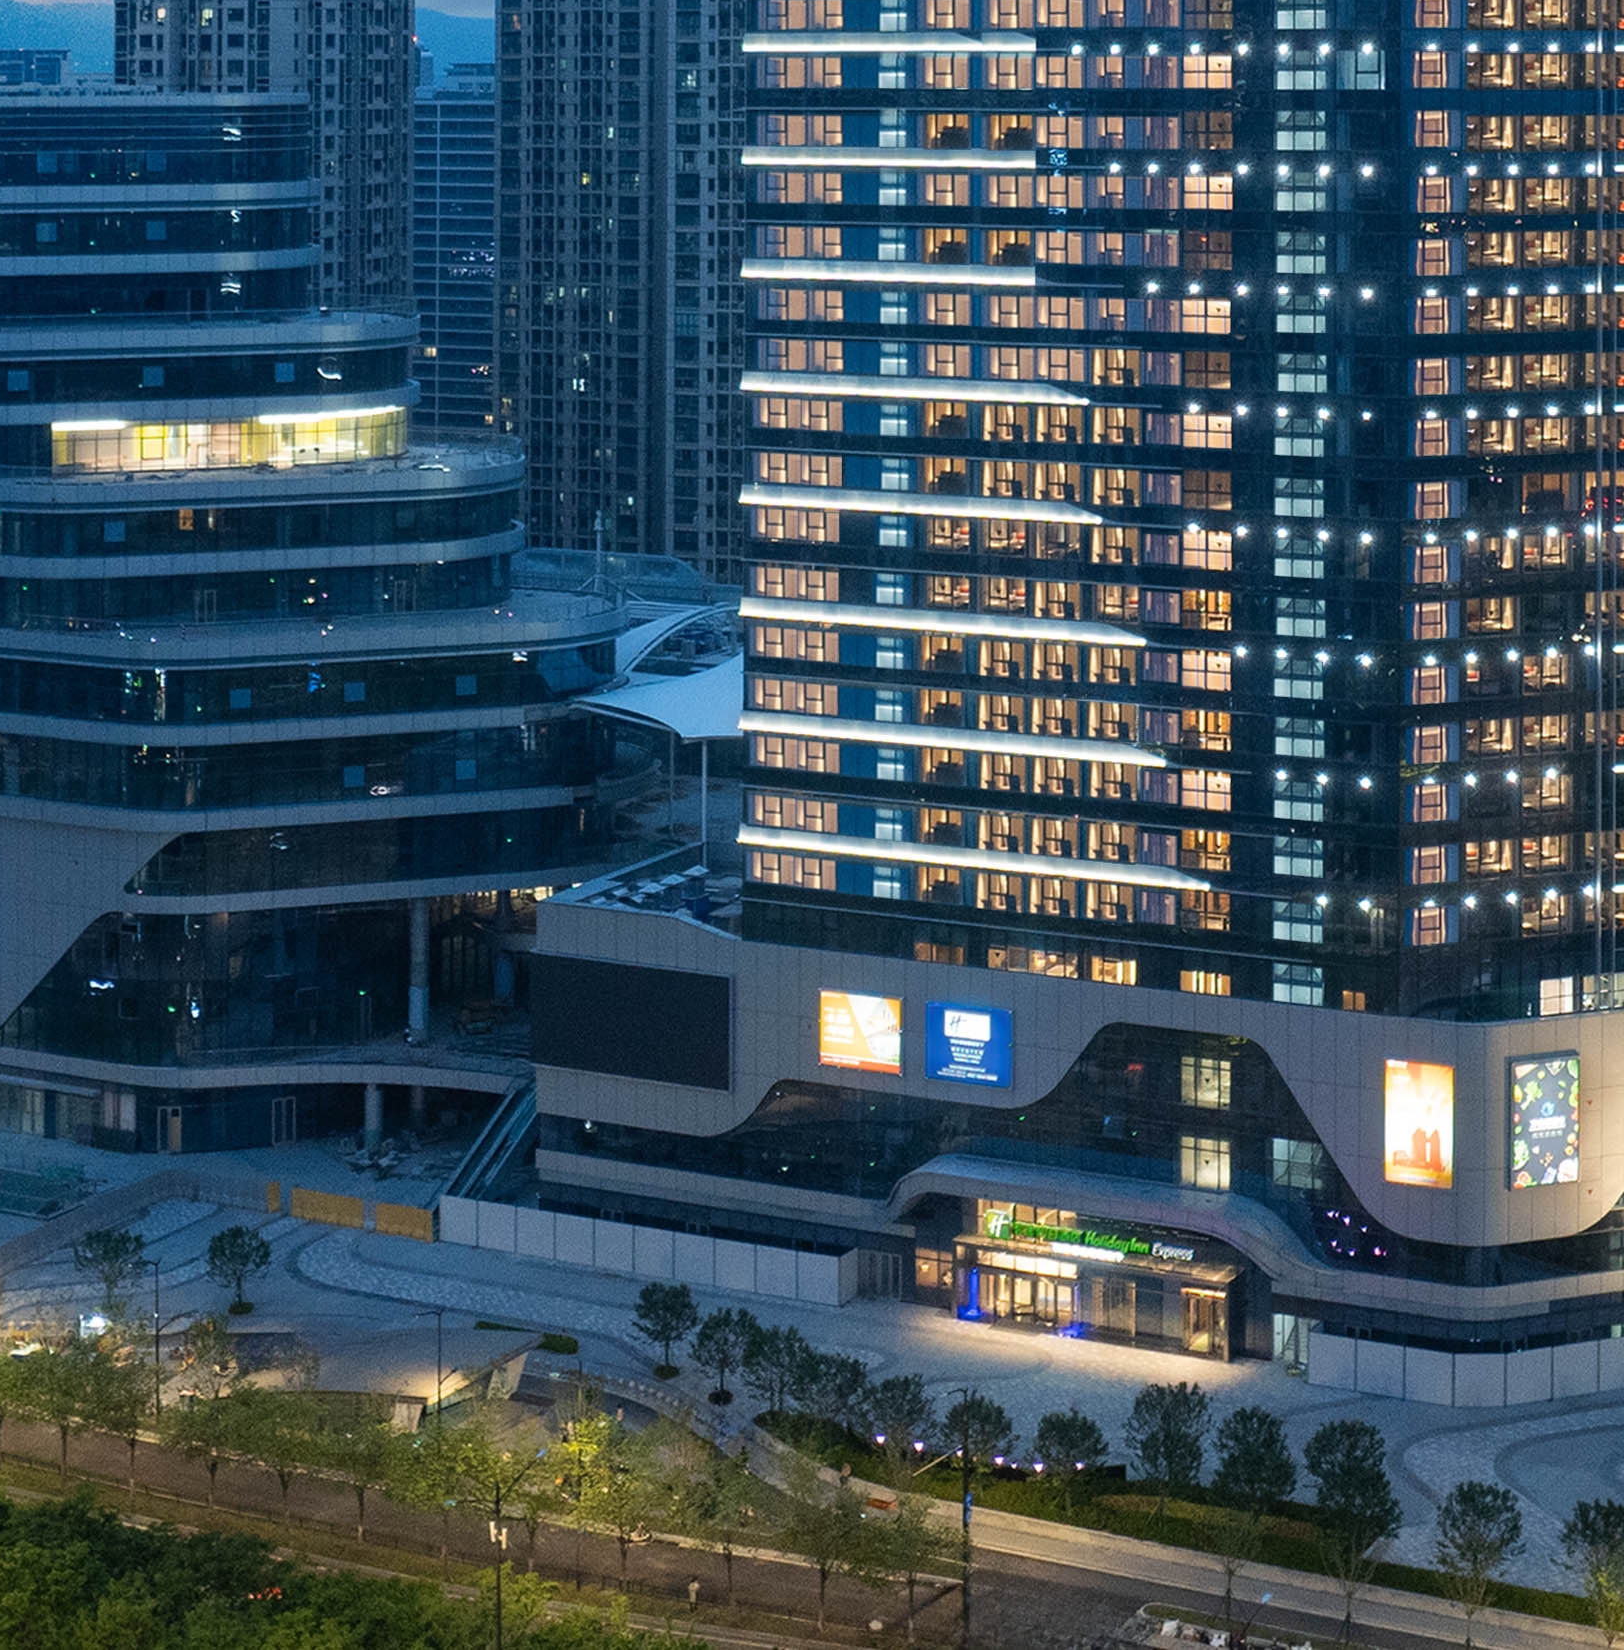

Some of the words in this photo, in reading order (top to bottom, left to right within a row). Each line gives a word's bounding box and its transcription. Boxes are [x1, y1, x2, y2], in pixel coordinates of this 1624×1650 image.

[1085, 1230, 1129, 1254] Holiday
[1130, 1237, 1150, 1254] Inn
[1152, 1242, 1194, 1261] Express
